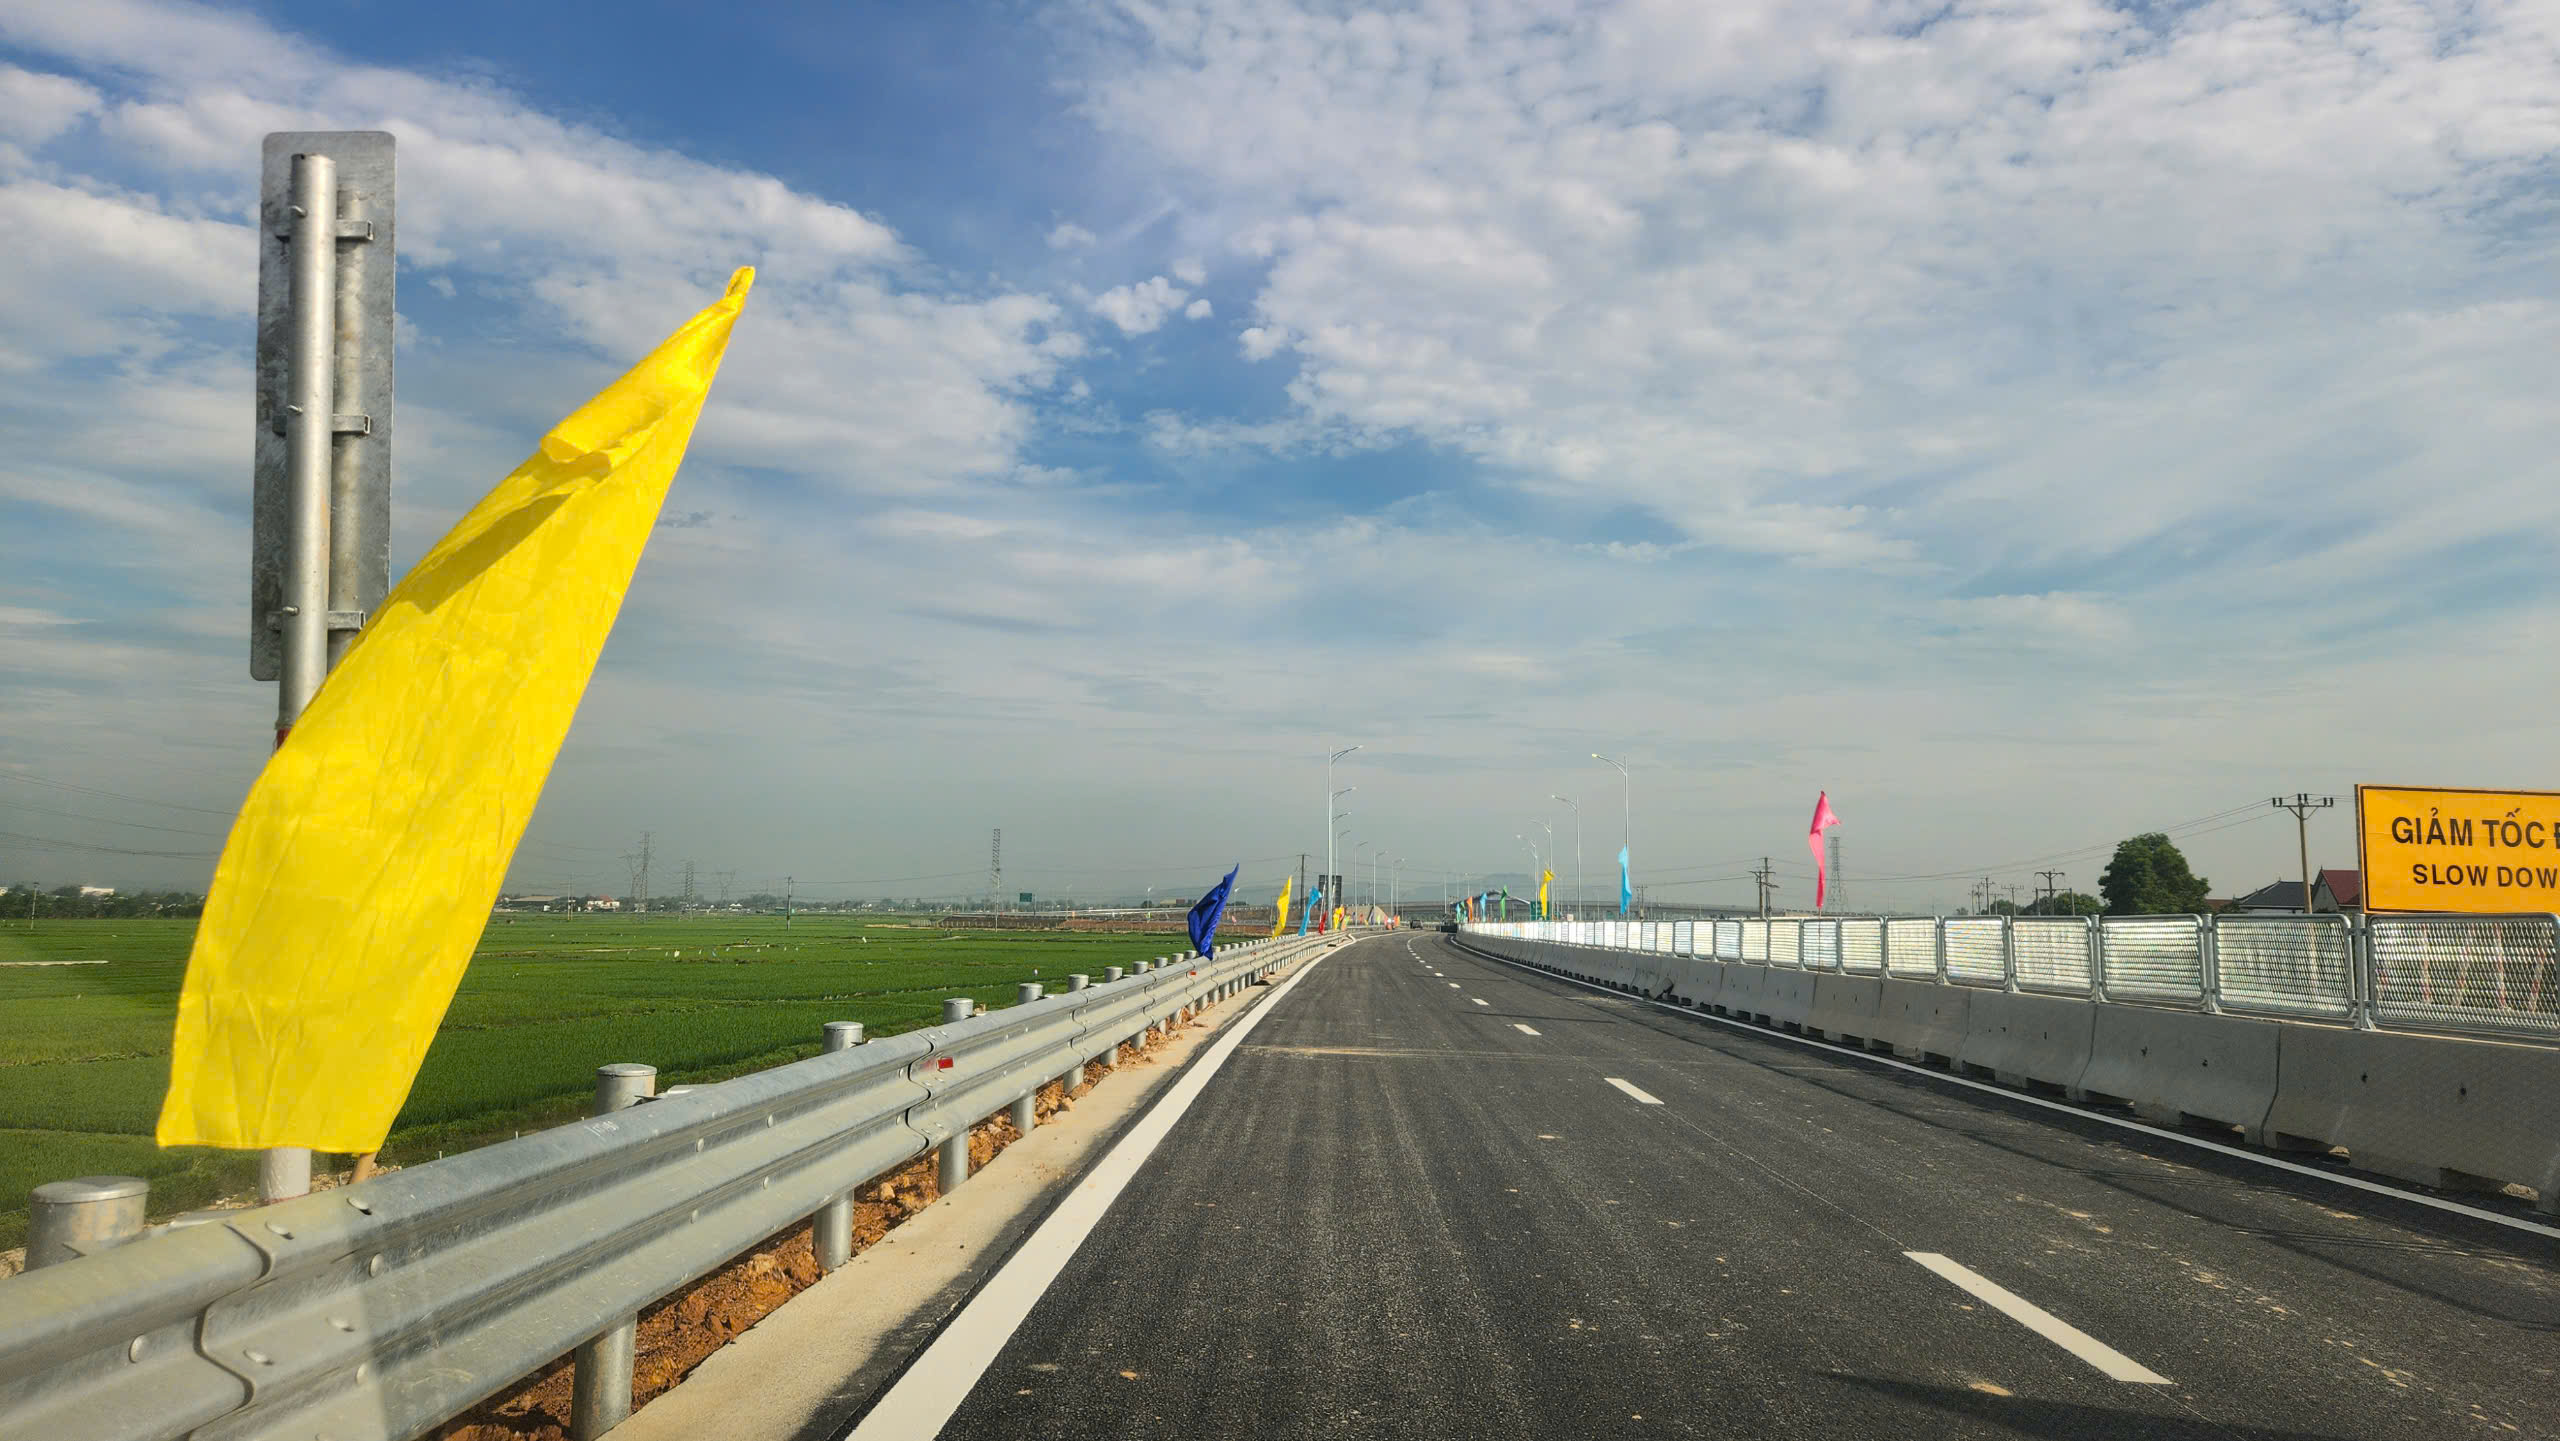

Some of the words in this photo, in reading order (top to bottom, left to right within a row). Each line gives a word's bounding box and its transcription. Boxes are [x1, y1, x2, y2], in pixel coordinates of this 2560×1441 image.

[2391, 807, 2473, 847] GIẢM
[2481, 807, 2545, 849] TỐC
[2412, 863, 2489, 887] SLOW
[2496, 866, 2559, 889] DOW
